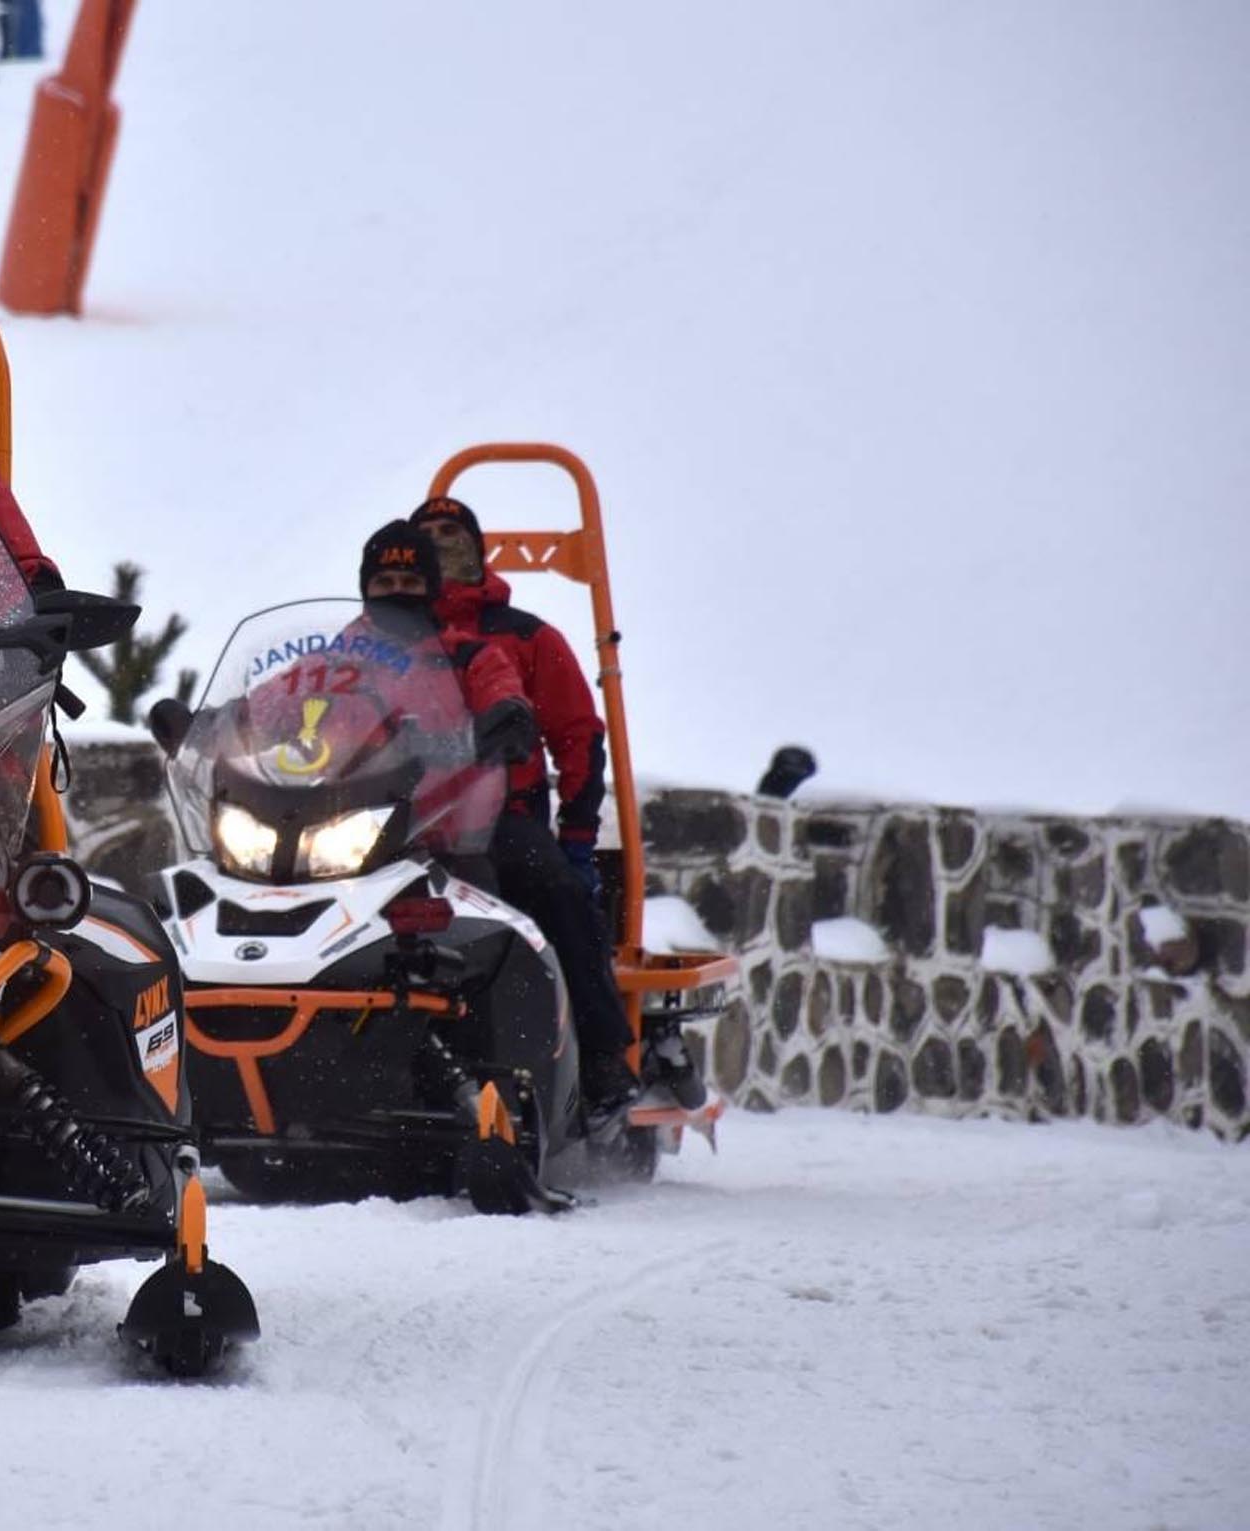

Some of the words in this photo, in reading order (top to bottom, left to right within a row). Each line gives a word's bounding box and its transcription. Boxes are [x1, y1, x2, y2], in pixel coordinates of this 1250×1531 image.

[380, 547, 415, 565] JAK
[252, 633, 412, 675] JANDARMA
[282, 664, 361, 696] 112
[133, 974, 169, 1029] LYNX
[147, 1021, 174, 1054] 69
